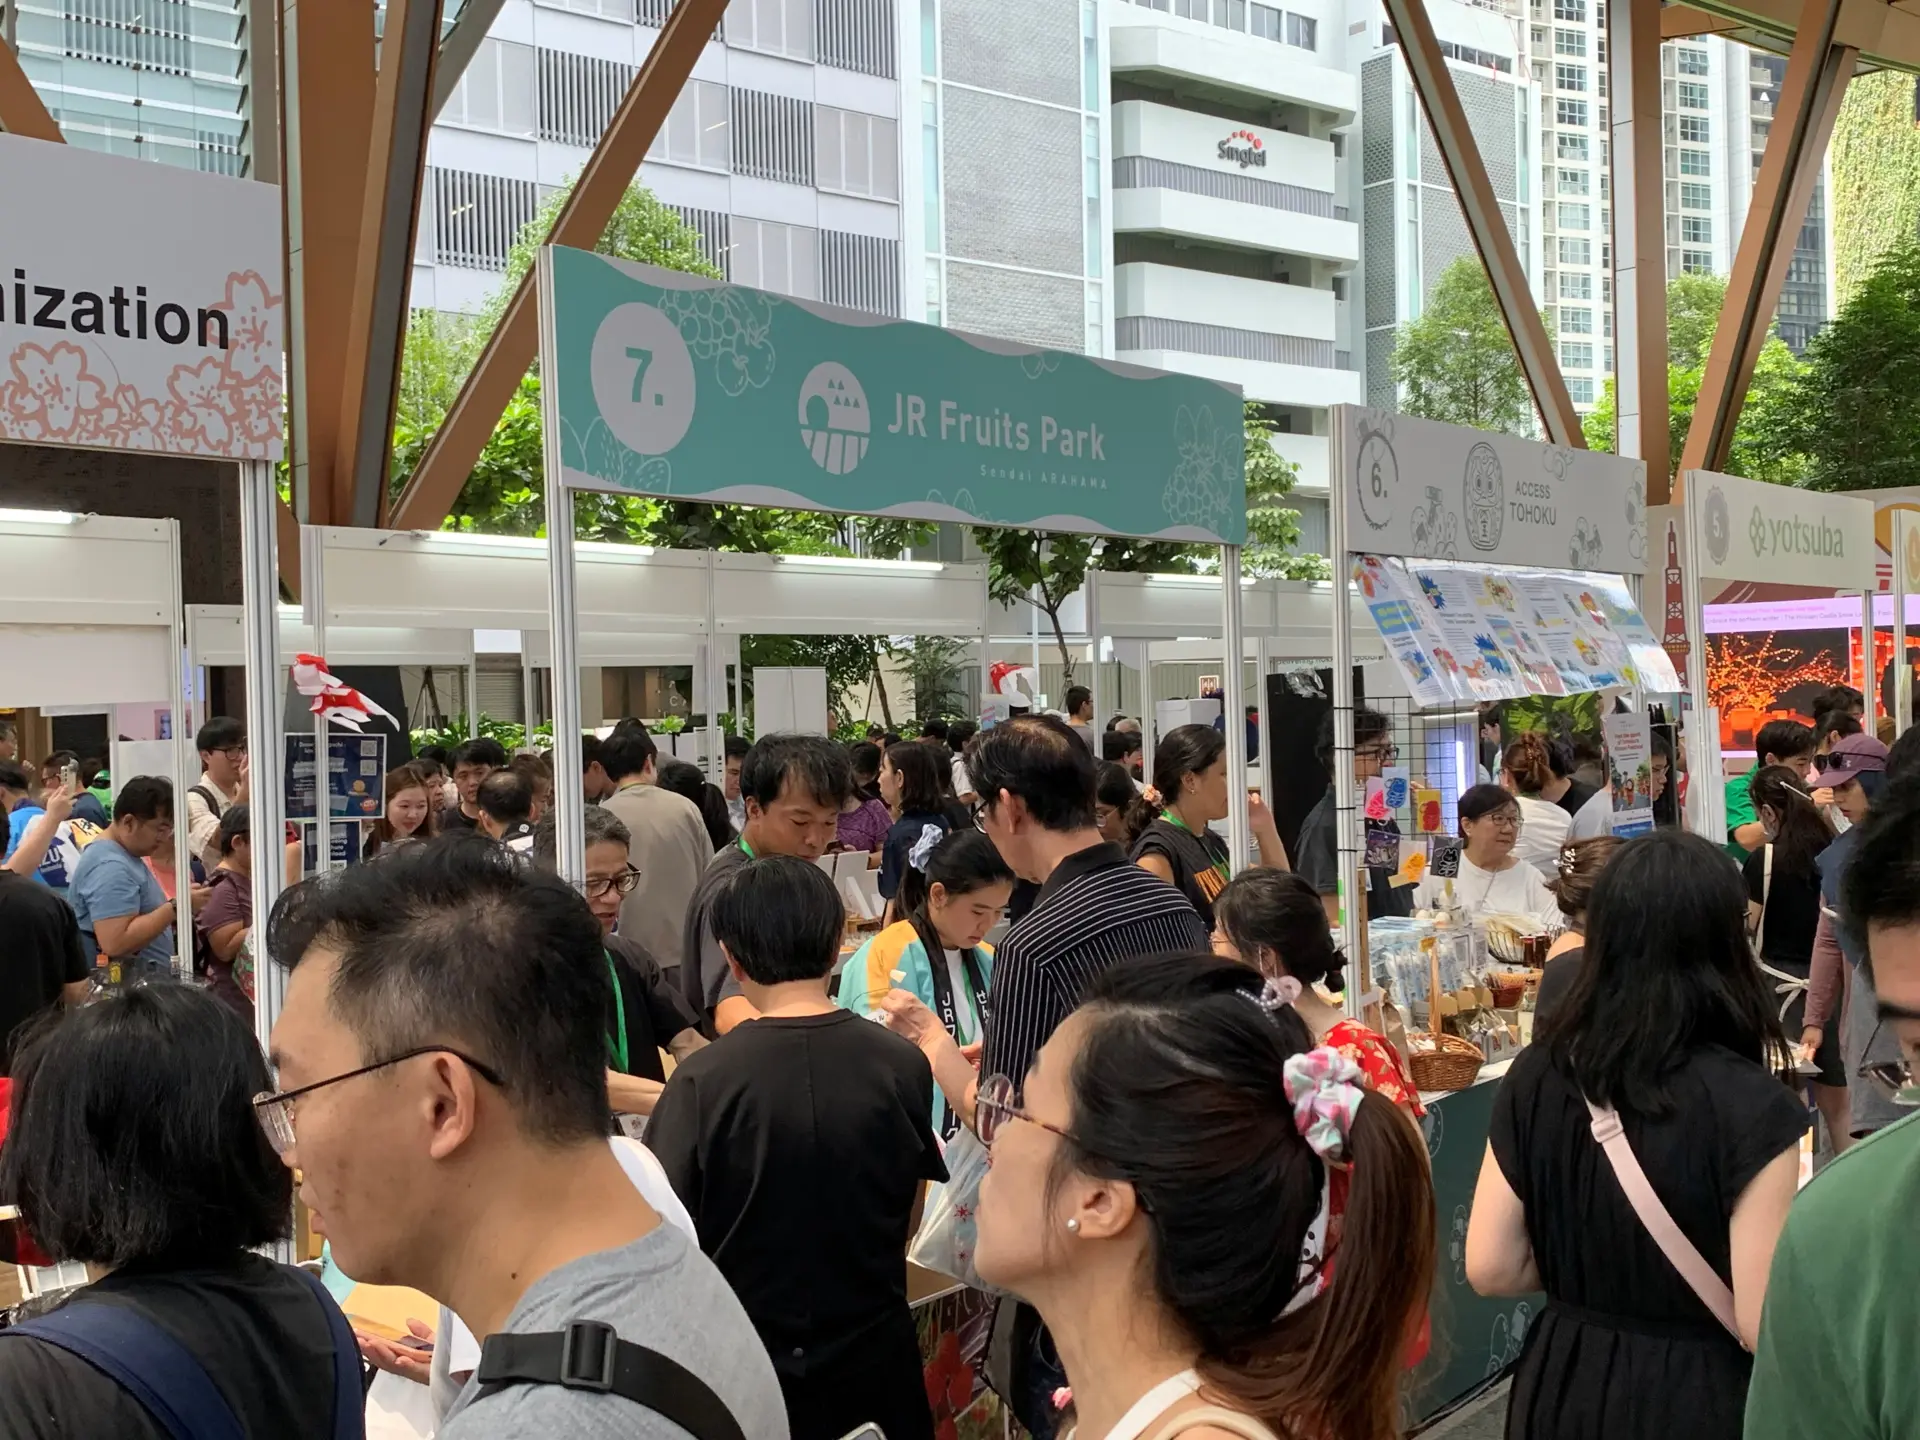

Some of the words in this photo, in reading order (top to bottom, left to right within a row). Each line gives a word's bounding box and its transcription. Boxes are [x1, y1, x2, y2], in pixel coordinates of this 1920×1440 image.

[1218, 140, 1267, 169] Singtel
[625, 347, 663, 406] 7.
[887, 392, 928, 438] JR
[940, 400, 1030, 451] Fruits
[1041, 416, 1105, 461] Park
[980, 464, 1032, 482] Sendai
[1041, 471, 1108, 490] ARAHAMA
[1371, 462, 1388, 499] 6.
[1515, 481, 1551, 499] ACCESS
[1509, 502, 1557, 526] TOHOKU
[1768, 514, 1845, 559] yotsuba
